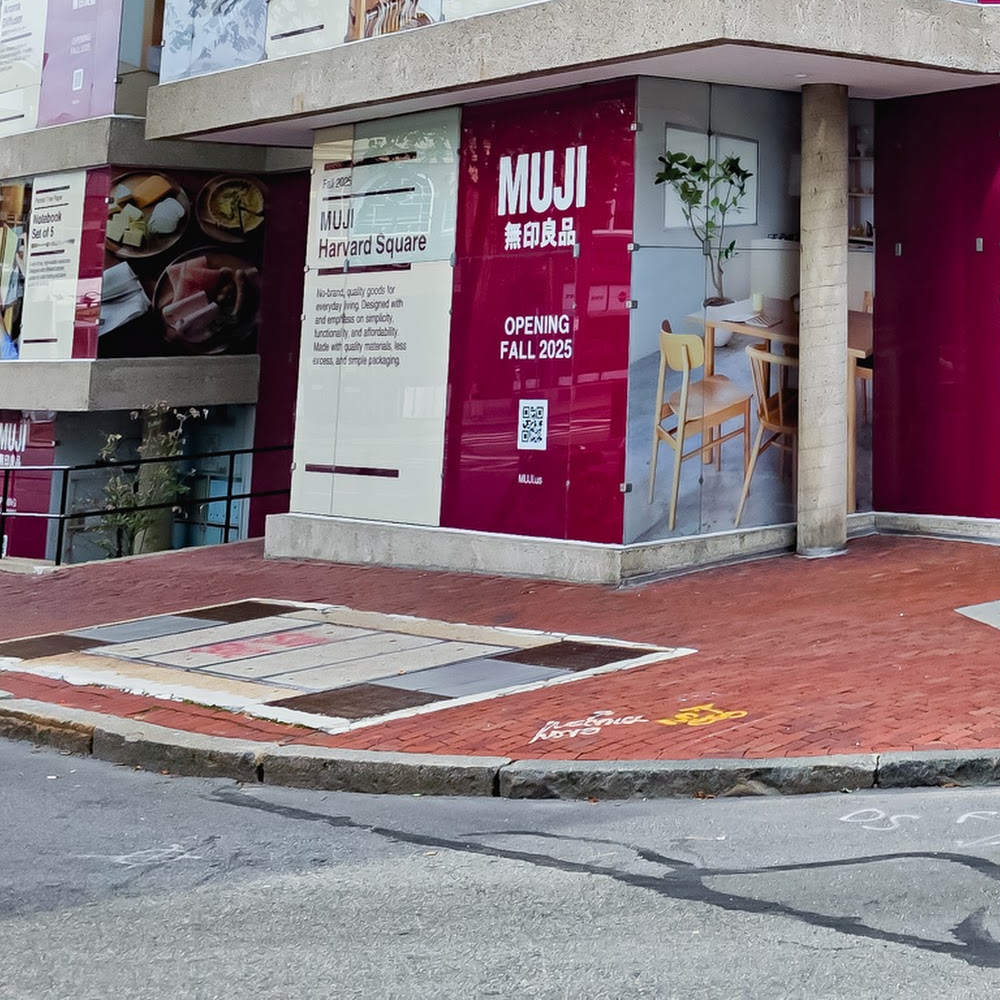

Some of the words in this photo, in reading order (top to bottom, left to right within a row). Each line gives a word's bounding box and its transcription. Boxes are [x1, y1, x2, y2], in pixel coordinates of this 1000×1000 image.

[498, 145, 587, 216] MUJI
[33, 211, 62, 225] Notebook
[321, 208, 354, 231] MUJI
[32, 228, 41, 239] Set
[42, 227, 49, 238] of
[50, 226, 54, 237] 5
[504, 217, 576, 251] 無印良品
[319, 235, 372, 258] Harvard
[376, 234, 427, 259] Square
[347, 287, 365, 298] quality
[366, 285, 385, 297] goods
[386, 285, 396, 294] for
[316, 301, 342, 312] everyday
[361, 299, 389, 311] Designed
[391, 298, 403, 308] with
[315, 315, 326, 325] and
[504, 314, 569, 335] OPENING
[351, 328, 362, 337] and
[313, 342, 329, 351] Made
[331, 342, 342, 351] with
[344, 341, 363, 353] quality
[394, 341, 407, 350] less
[500, 340, 536, 360] FALL
[539, 339, 572, 359] 2025
[335, 355, 347, 365] and
[348, 355, 367, 366] simple
